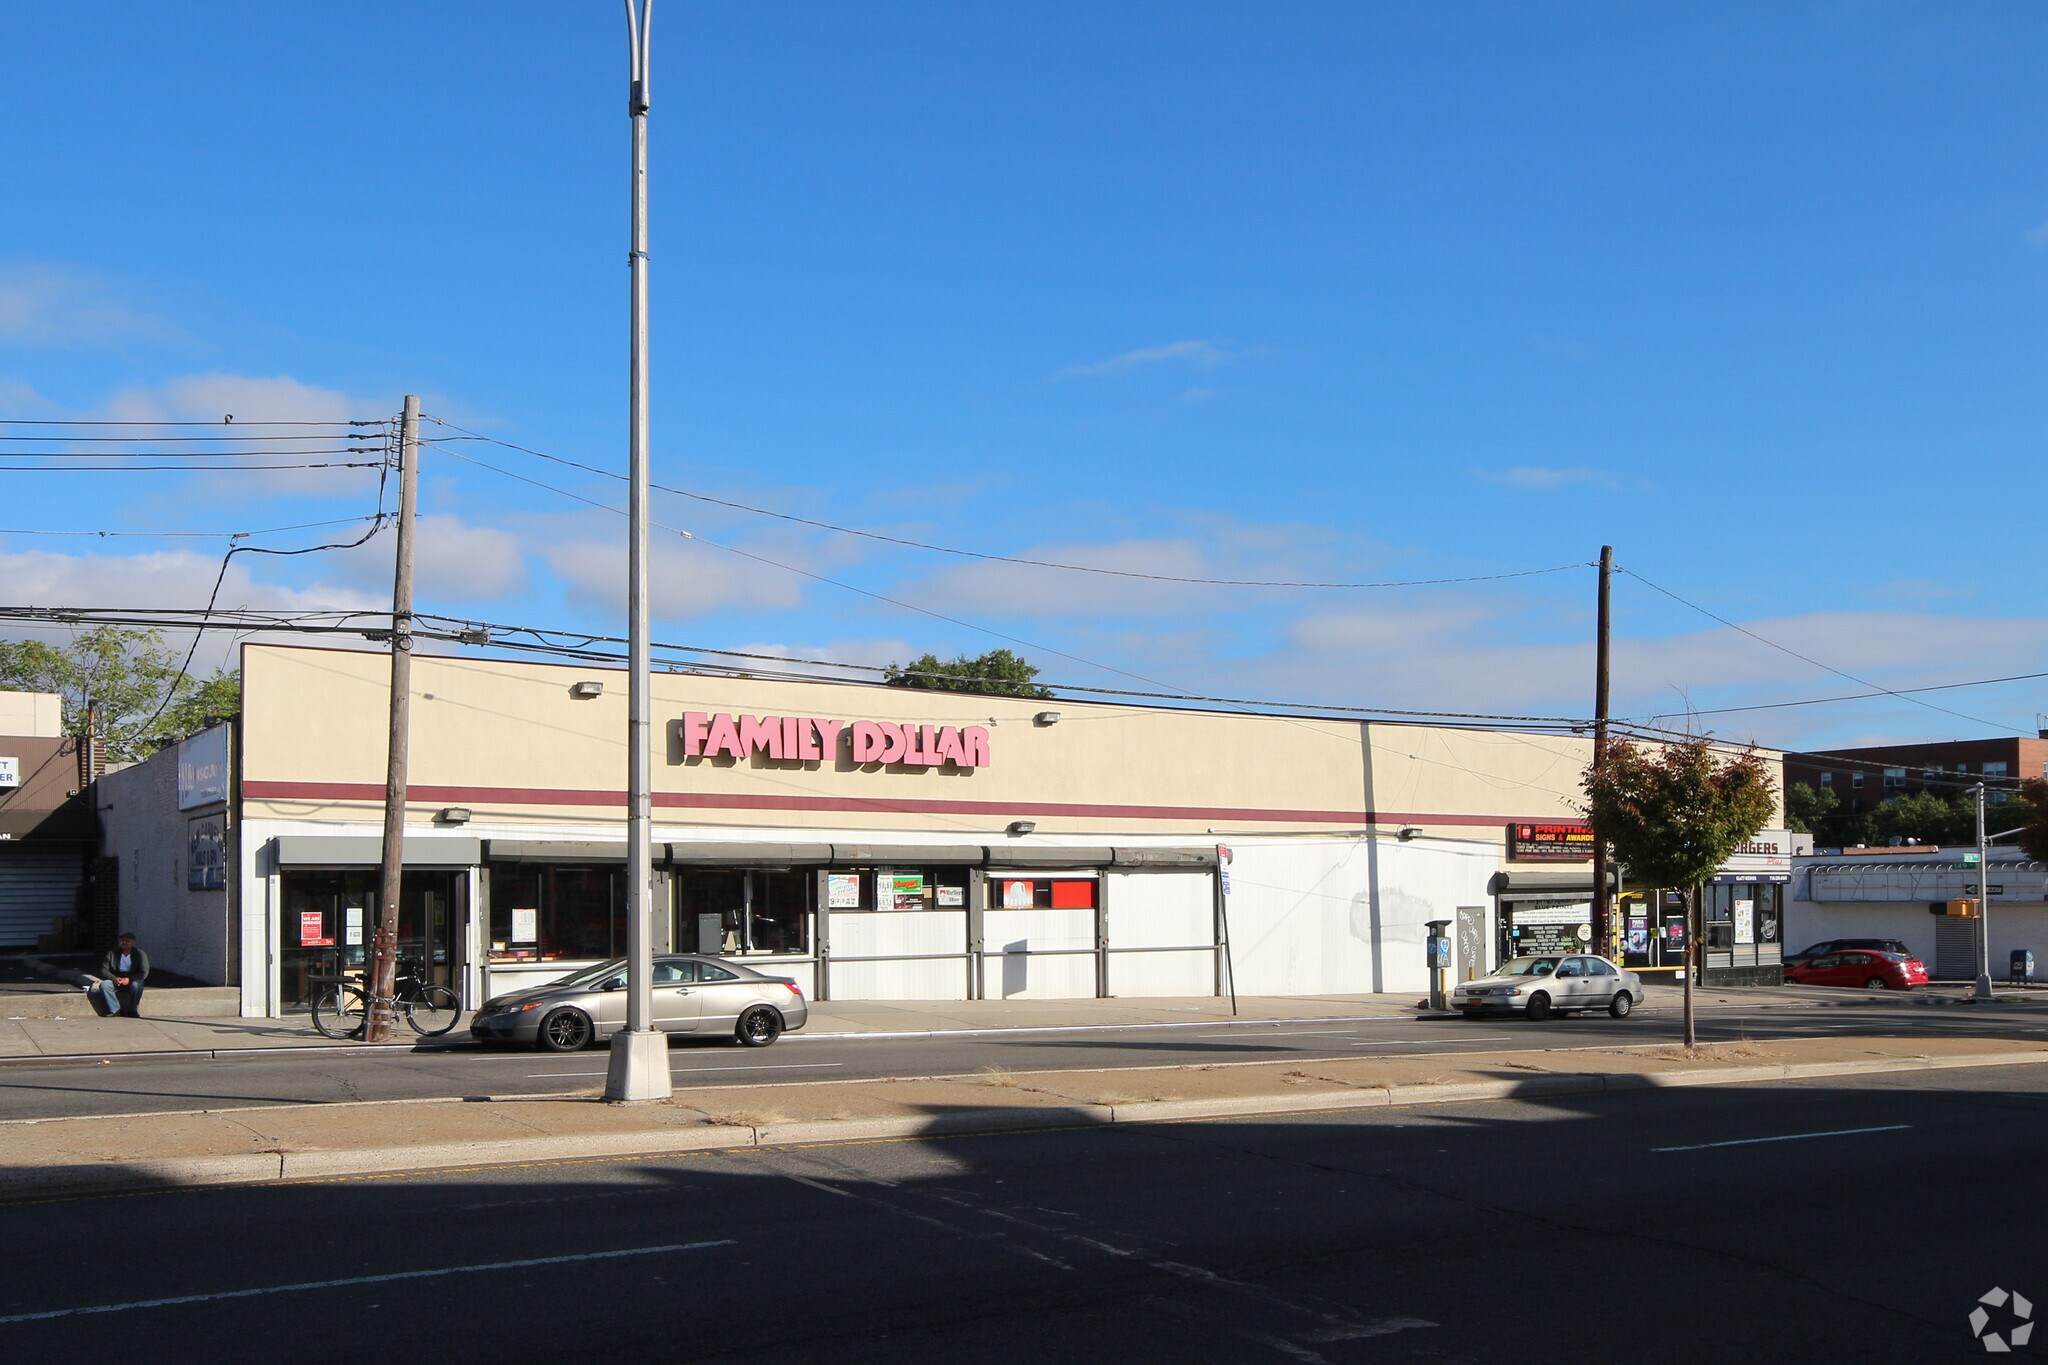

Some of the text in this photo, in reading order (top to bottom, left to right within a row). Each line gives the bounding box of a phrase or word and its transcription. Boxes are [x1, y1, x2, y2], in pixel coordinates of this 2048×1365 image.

[682, 711, 991, 768] FAMILY DOLLAR
[0, 761, 8, 769] T
[1535, 825, 1594, 833] PRINTING
[1734, 842, 1779, 854] URGERS
[1766, 856, 1783, 865] Plus
